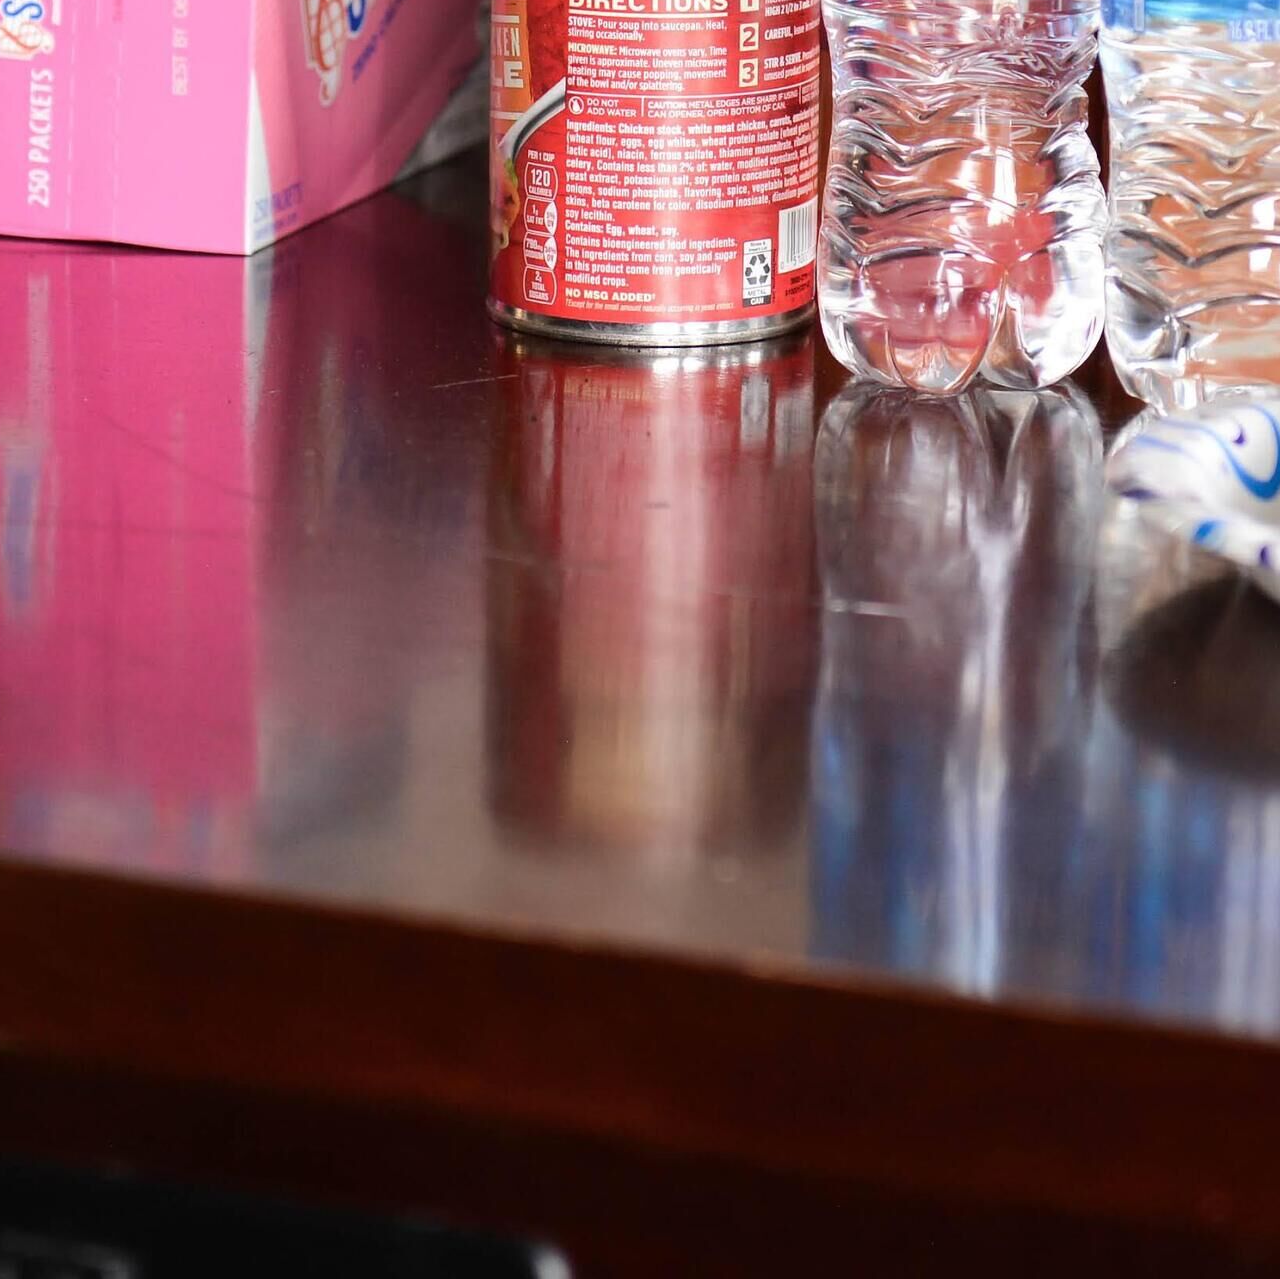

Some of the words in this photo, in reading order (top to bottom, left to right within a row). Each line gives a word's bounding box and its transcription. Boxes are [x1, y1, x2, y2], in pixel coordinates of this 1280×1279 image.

[568, 16, 596, 29] STOVE:
[598, 18, 617, 29] Pour
[618, 21, 639, 32] soup
[641, 20, 658, 30] into
[660, 22, 704, 32] saucepan.
[172, 27, 188, 48] BY
[568, 29, 594, 40] stirring
[595, 30, 646, 42] occasionally.
[742, 26, 756, 47] 2
[568, 42, 617, 56] MICROWAVE:
[618, 46, 661, 57] Microwave
[663, 48, 686, 57] ovens
[688, 48, 708, 59] vary.
[709, 46, 727, 56] Time
[568, 55, 588, 67] given
[597, 57, 651, 69] approximate.
[652, 58, 683, 68] Uneven
[684, 57, 728, 68] microwave
[172, 54, 188, 96] BEST
[568, 66, 597, 78] heating
[598, 68, 616, 79] may
[618, 70, 642, 79] cause
[644, 70, 682, 81] popping,
[683, 68, 727, 79] movement
[742, 62, 756, 84] 3
[567, 76, 575, 86] of
[577, 77, 589, 87] the
[590, 78, 609, 89] bowl
[610, 79, 638, 90] and/or
[587, 97, 599, 107] DO
[601, 98, 619, 108] NOT
[648, 109, 667, 118] CAN
[707, 107, 729, 117] OPEN
[730, 104, 762, 115] BOTTOM
[761, 103, 772, 112] OF
[687, 99, 715, 109] METAL
[716, 98, 741, 108] EDGES
[741, 96, 756, 106] ARE
[28, 68, 54, 164] PACKETS
[586, 106, 605, 115] ADD
[606, 108, 637, 118] WATER
[566, 118, 616, 133] Ingredients:
[618, 123, 655, 135] Chicken
[687, 124, 712, 135] white
[714, 122, 735, 133] meat
[736, 120, 769, 132] chicken,
[566, 131, 594, 144] (wheat
[648, 138, 664, 149] egg
[701, 136, 727, 147] wheat
[728, 133, 756, 146] protein
[757, 130, 779, 142] isolate
[527, 149, 539, 160] PER
[542, 152, 556, 163] CUP
[566, 144, 588, 157] lactic
[650, 149, 682, 160] ferrous
[719, 146, 753, 159] thiamine
[596, 160, 634, 173] Contains
[636, 162, 655, 173] less
[657, 162, 677, 173] than
[679, 162, 694, 173] 2%
[737, 157, 769, 169] modified
[530, 168, 551, 187] 120
[566, 171, 587, 182] yeast
[623, 174, 670, 186] potassium
[694, 175, 709, 187] soy
[711, 173, 740, 186] protein
[27, 169, 50, 208] 250
[597, 186, 630, 197] sodium
[751, 180, 783, 193] vegetable
[591, 197, 610, 209] beta
[612, 199, 651, 211] carotene
[653, 200, 666, 210] for
[695, 198, 734, 210] disodium
[565, 208, 579, 220] soy
[581, 209, 616, 222] lecithin.
[565, 219, 604, 233] Contains:
[565, 234, 600, 247] Contains
[602, 237, 665, 251] bioengineered
[667, 238, 687, 250] food
[688, 237, 738, 251] ingredients.
[565, 246, 579, 258] The
[581, 248, 629, 263] ingredients
[631, 251, 653, 263] from
[679, 253, 695, 265] soy
[697, 251, 713, 261] and
[714, 250, 738, 263] sugar
[565, 259, 573, 270] in
[574, 260, 590, 272] this
[591, 262, 624, 276] product
[625, 265, 650, 275] come
[652, 264, 674, 275] from
[674, 263, 722, 277] genetically
[565, 272, 600, 285] modified
[602, 275, 630, 287] crops.
[565, 287, 581, 297] NO
[583, 290, 609, 300] MSG
[750, 297, 765, 306] CAN
